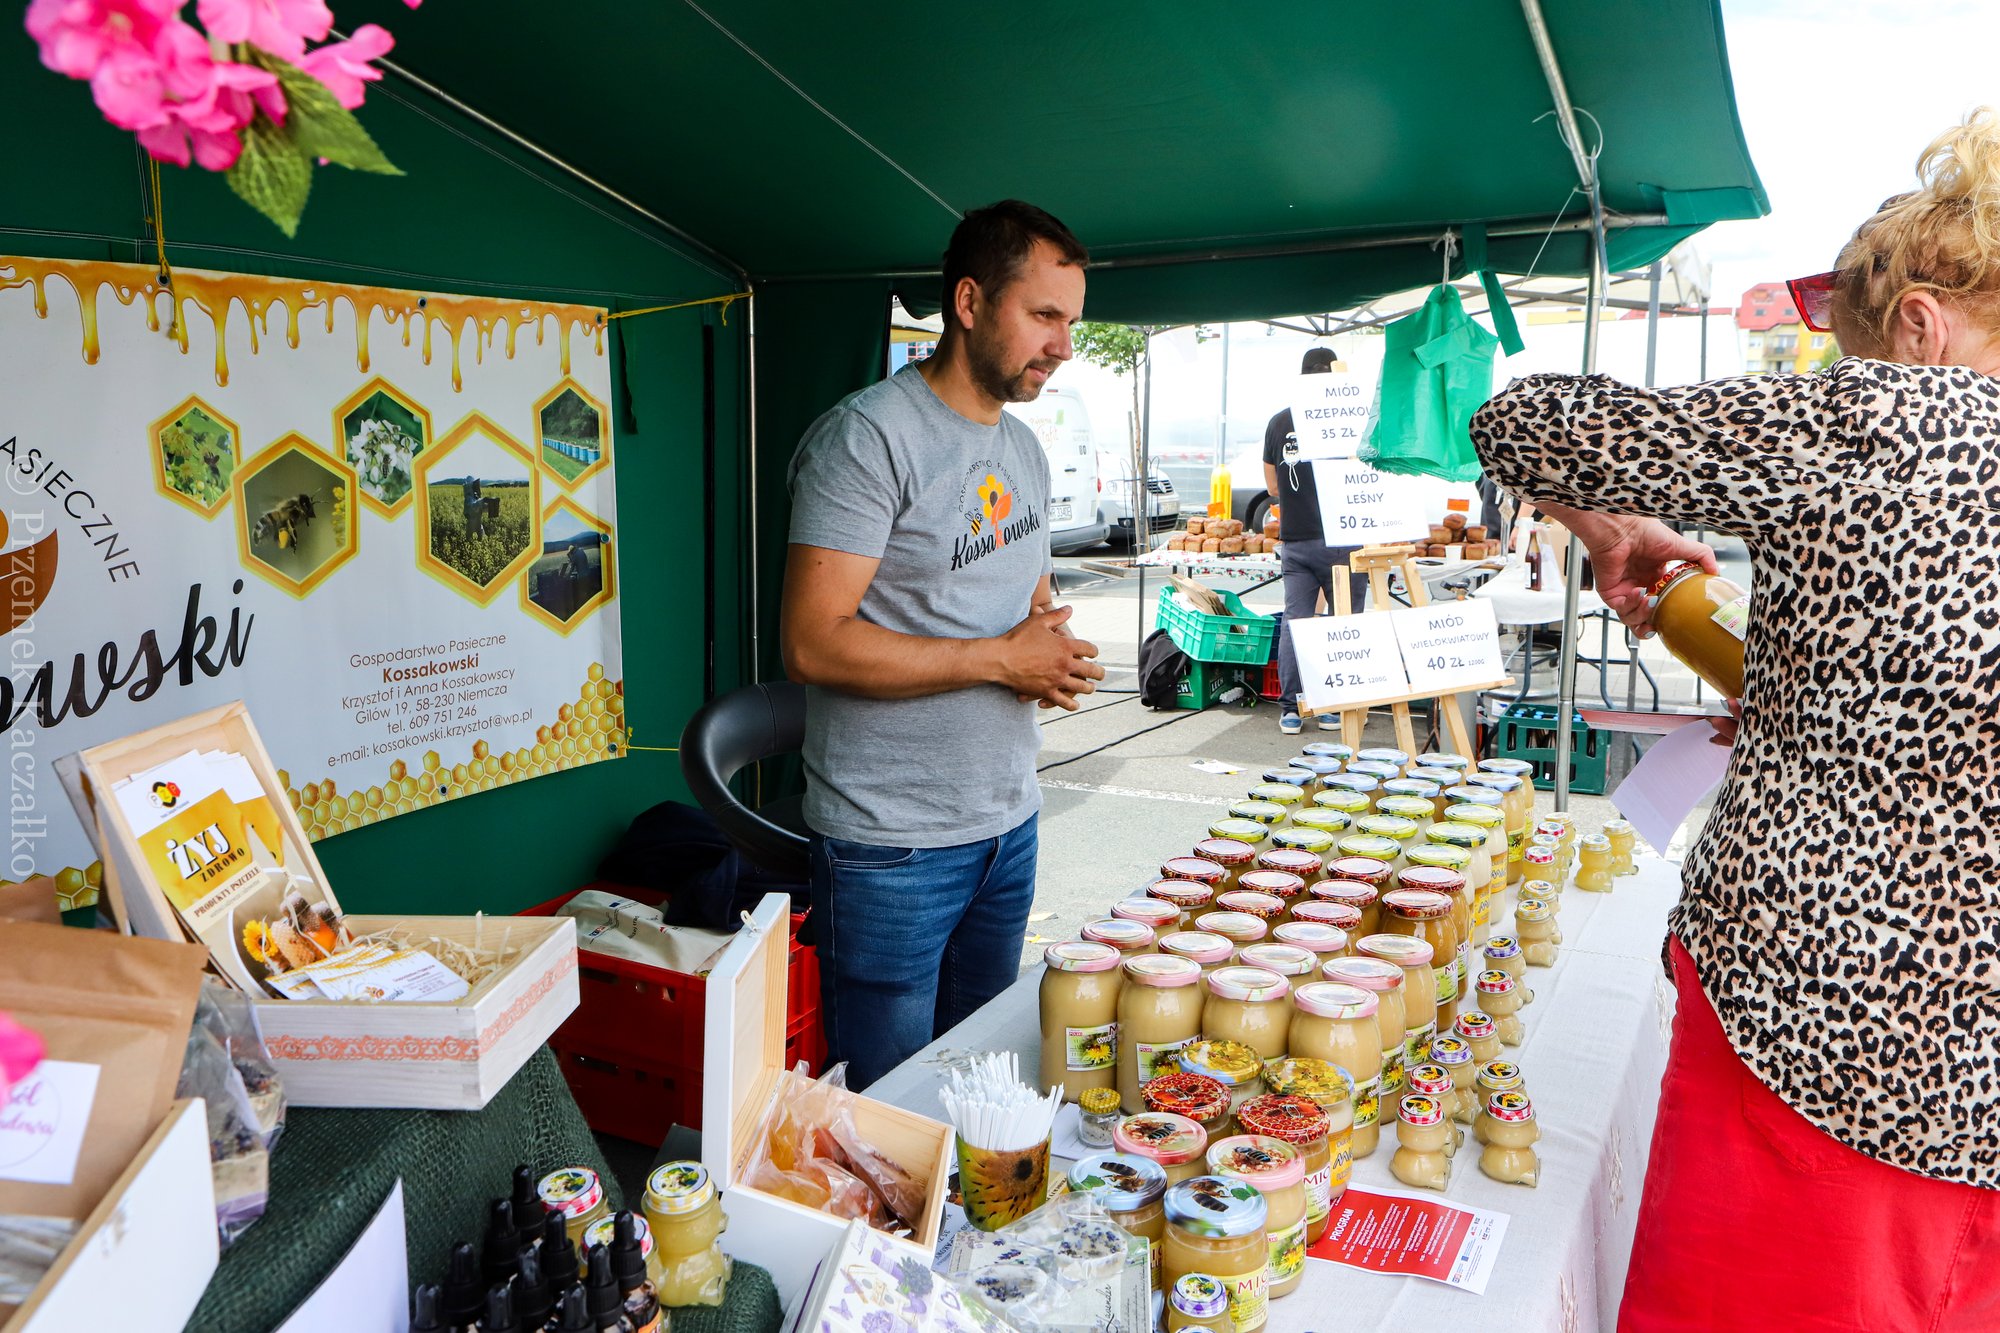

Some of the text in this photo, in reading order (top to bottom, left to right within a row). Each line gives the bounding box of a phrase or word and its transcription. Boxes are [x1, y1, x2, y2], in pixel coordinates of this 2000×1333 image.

[1325, 383, 1360, 398] MIÓD
[1322, 427, 1358, 439] 35 ZŁ
[1345, 470, 1379, 485] MIÓD
[1346, 490, 1384, 505] LEŚNY
[1340, 516, 1357, 529] 50
[1361, 517, 1378, 528] ZŁ
[951, 504, 1040, 571] Kossakowski
[1327, 626, 1361, 642] MIÓD
[1428, 614, 1464, 630] MIÓD
[350, 633, 507, 668] Gospodarstwo Pasieczne
[1410, 632, 1490, 650] WIELOKWIATOWY
[1326, 648, 1371, 663] LIPOWY
[1427, 656, 1446, 670] 40
[1450, 656, 1465, 668] ZŁ
[383, 652, 479, 684] Kossakowski
[342, 667, 516, 710] Krzysztof i Anna Kossakowscy
[1324, 673, 1345, 689] 45
[1349, 673, 1365, 685] ZŁ
[355, 708, 391, 725] Gilów
[415, 693, 455, 712] 58-230
[458, 683, 508, 704] Niemcza
[388, 704, 478, 735] tel. 609 751 246
[328, 707, 533, 767] e-mail: kossakowski.krzysztof@wp.pl
[166, 823, 231, 880] ŻYJ
[200, 847, 246, 883] ZDROWO
[194, 886, 232, 918] PRODUKTY
[230, 866, 262, 893] PSZCZELE
[1329, 1208, 1355, 1242] PROGRAM
